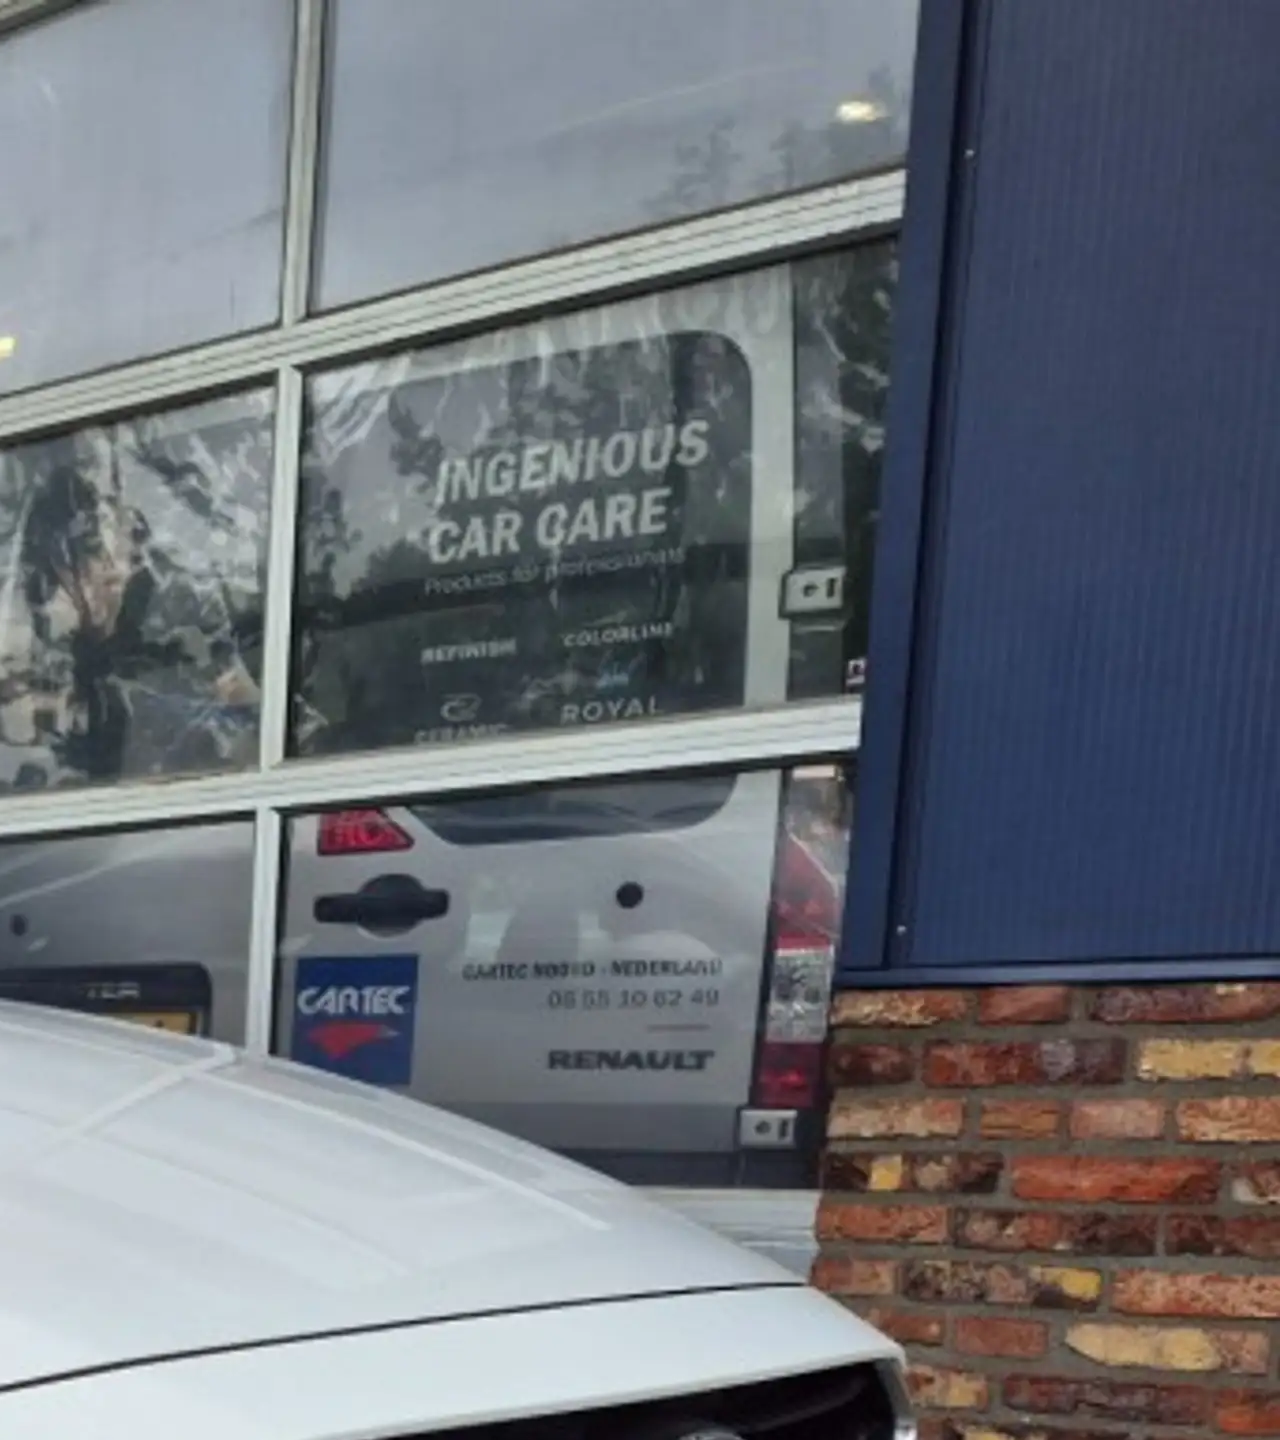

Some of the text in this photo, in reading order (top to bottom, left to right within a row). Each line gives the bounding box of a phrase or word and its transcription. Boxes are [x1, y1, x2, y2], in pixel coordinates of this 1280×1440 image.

[433, 419, 709, 506] INGENIOUS
[428, 487, 671, 564] CAR CARE
[421, 638, 517, 664] REFINISH
[560, 696, 658, 724] ROYAL
[462, 964, 528, 981] CARTEC
[611, 958, 723, 977] NEDERLAND
[297, 985, 411, 1015] CARTEC
[548, 1050, 715, 1070] RENAULT
